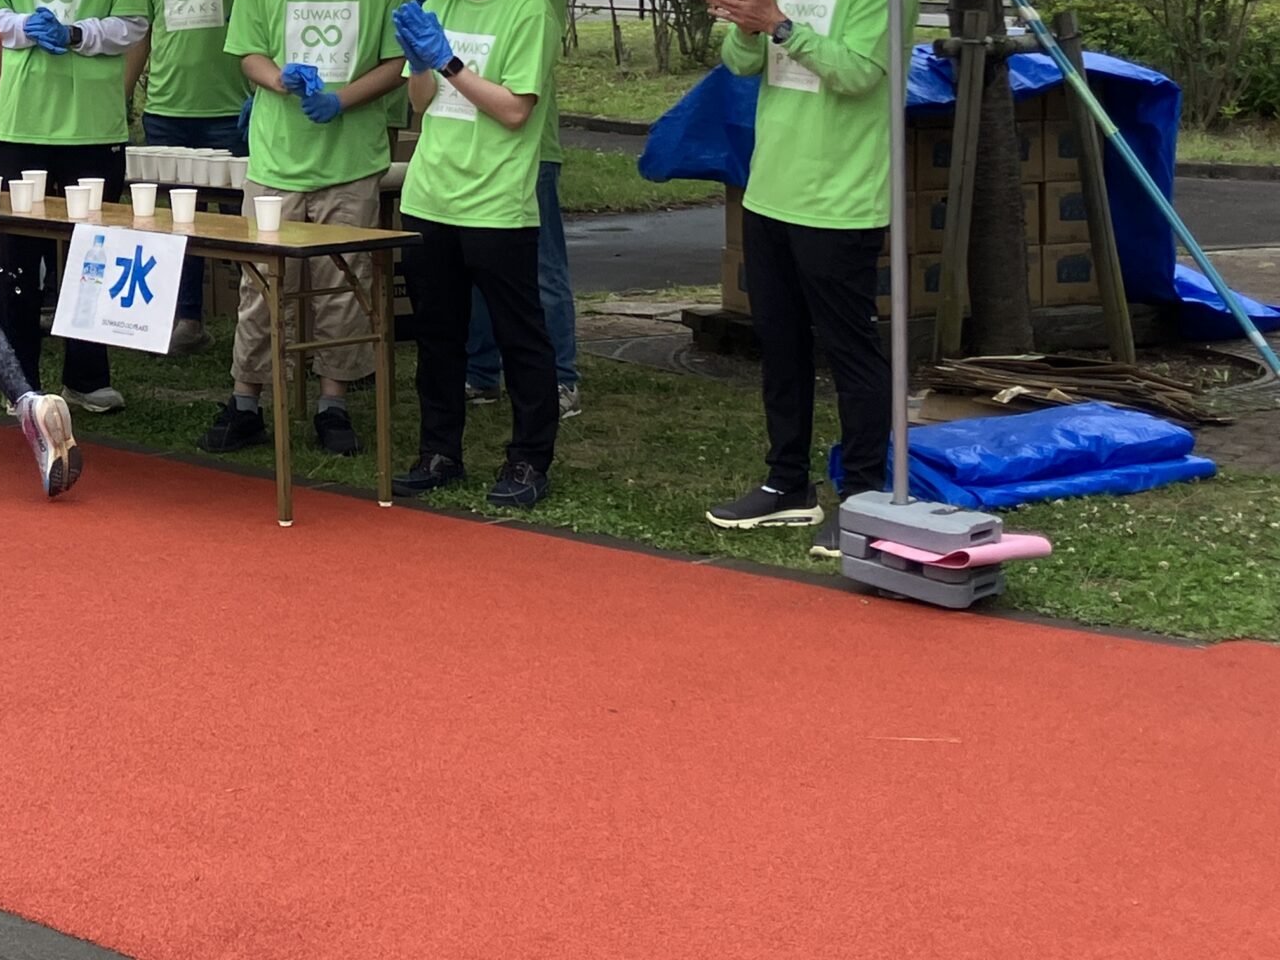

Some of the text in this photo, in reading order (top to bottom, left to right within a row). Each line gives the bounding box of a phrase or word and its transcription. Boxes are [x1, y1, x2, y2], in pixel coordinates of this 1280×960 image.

[293, 8, 352, 20] SUWAKO
[448, 39, 491, 55] UWAKO
[292, 52, 351, 64] PEAKS
[108, 244, 157, 307] 水
